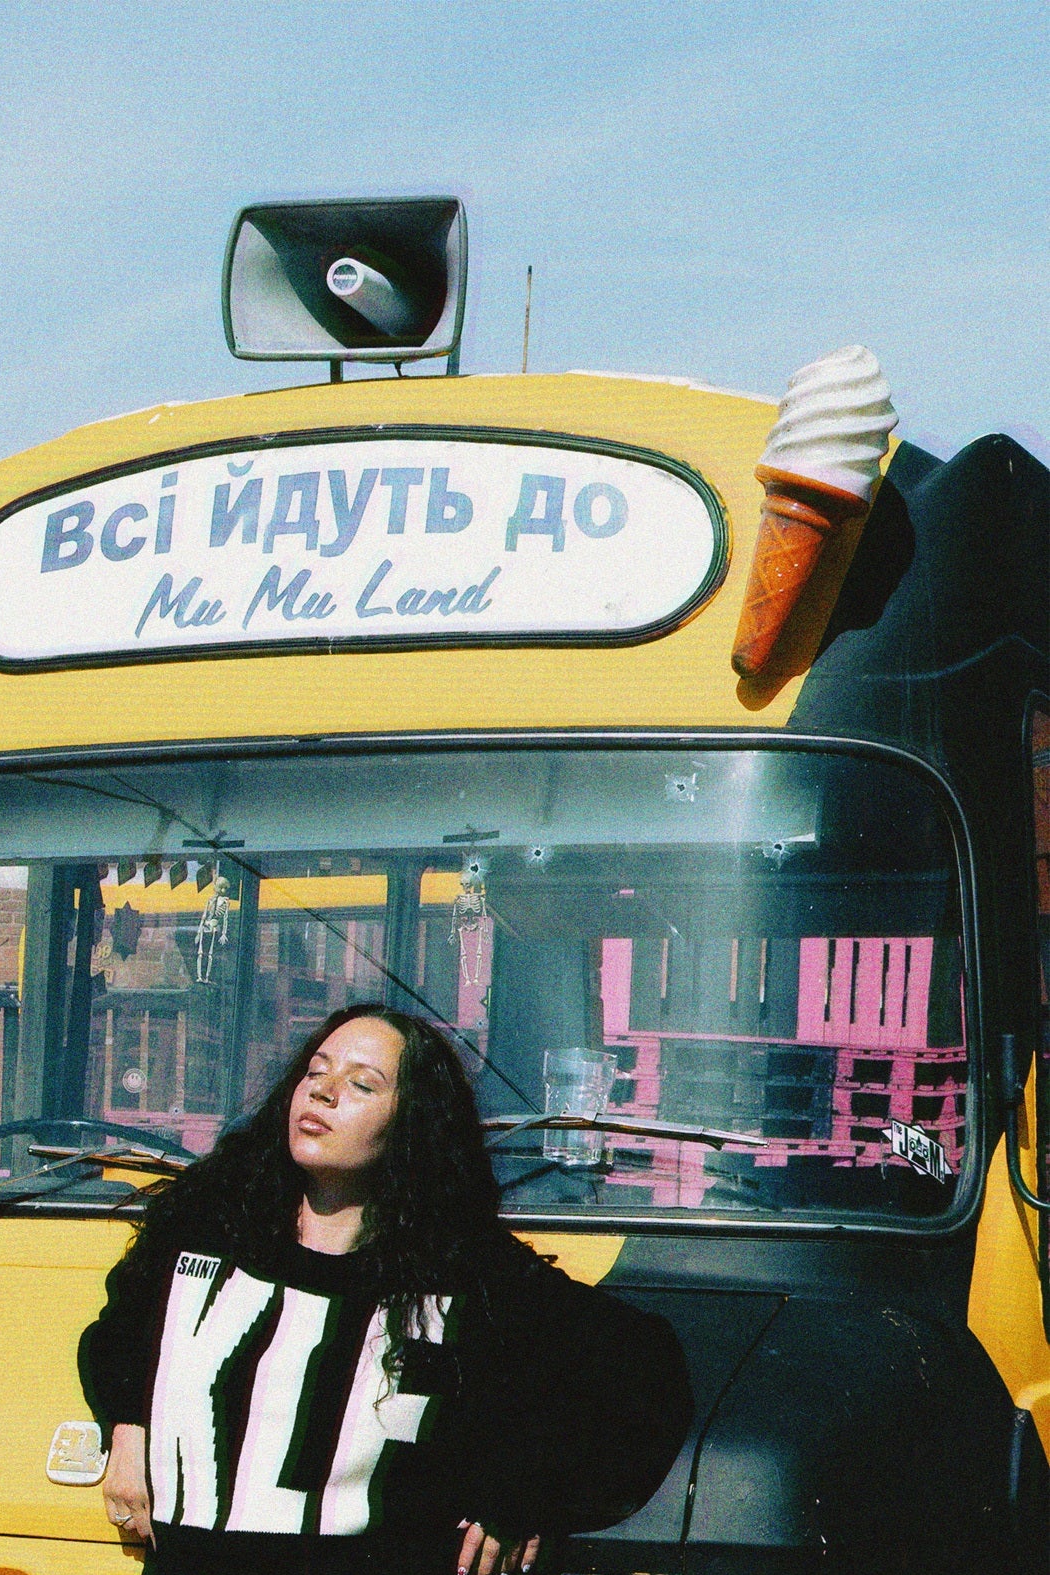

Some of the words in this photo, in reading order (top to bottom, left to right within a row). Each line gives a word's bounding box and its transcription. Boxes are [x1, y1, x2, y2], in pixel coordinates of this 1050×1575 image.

[40, 470, 180, 574] Всі
[209, 460, 474, 558] йдуть
[504, 472, 630, 553] до
[134, 572, 228, 639] Mu
[241, 565, 338, 631] Mu
[355, 558, 503, 619] Land
[177, 1255, 220, 1280] SAINT
[149, 1251, 453, 1536] KLF
